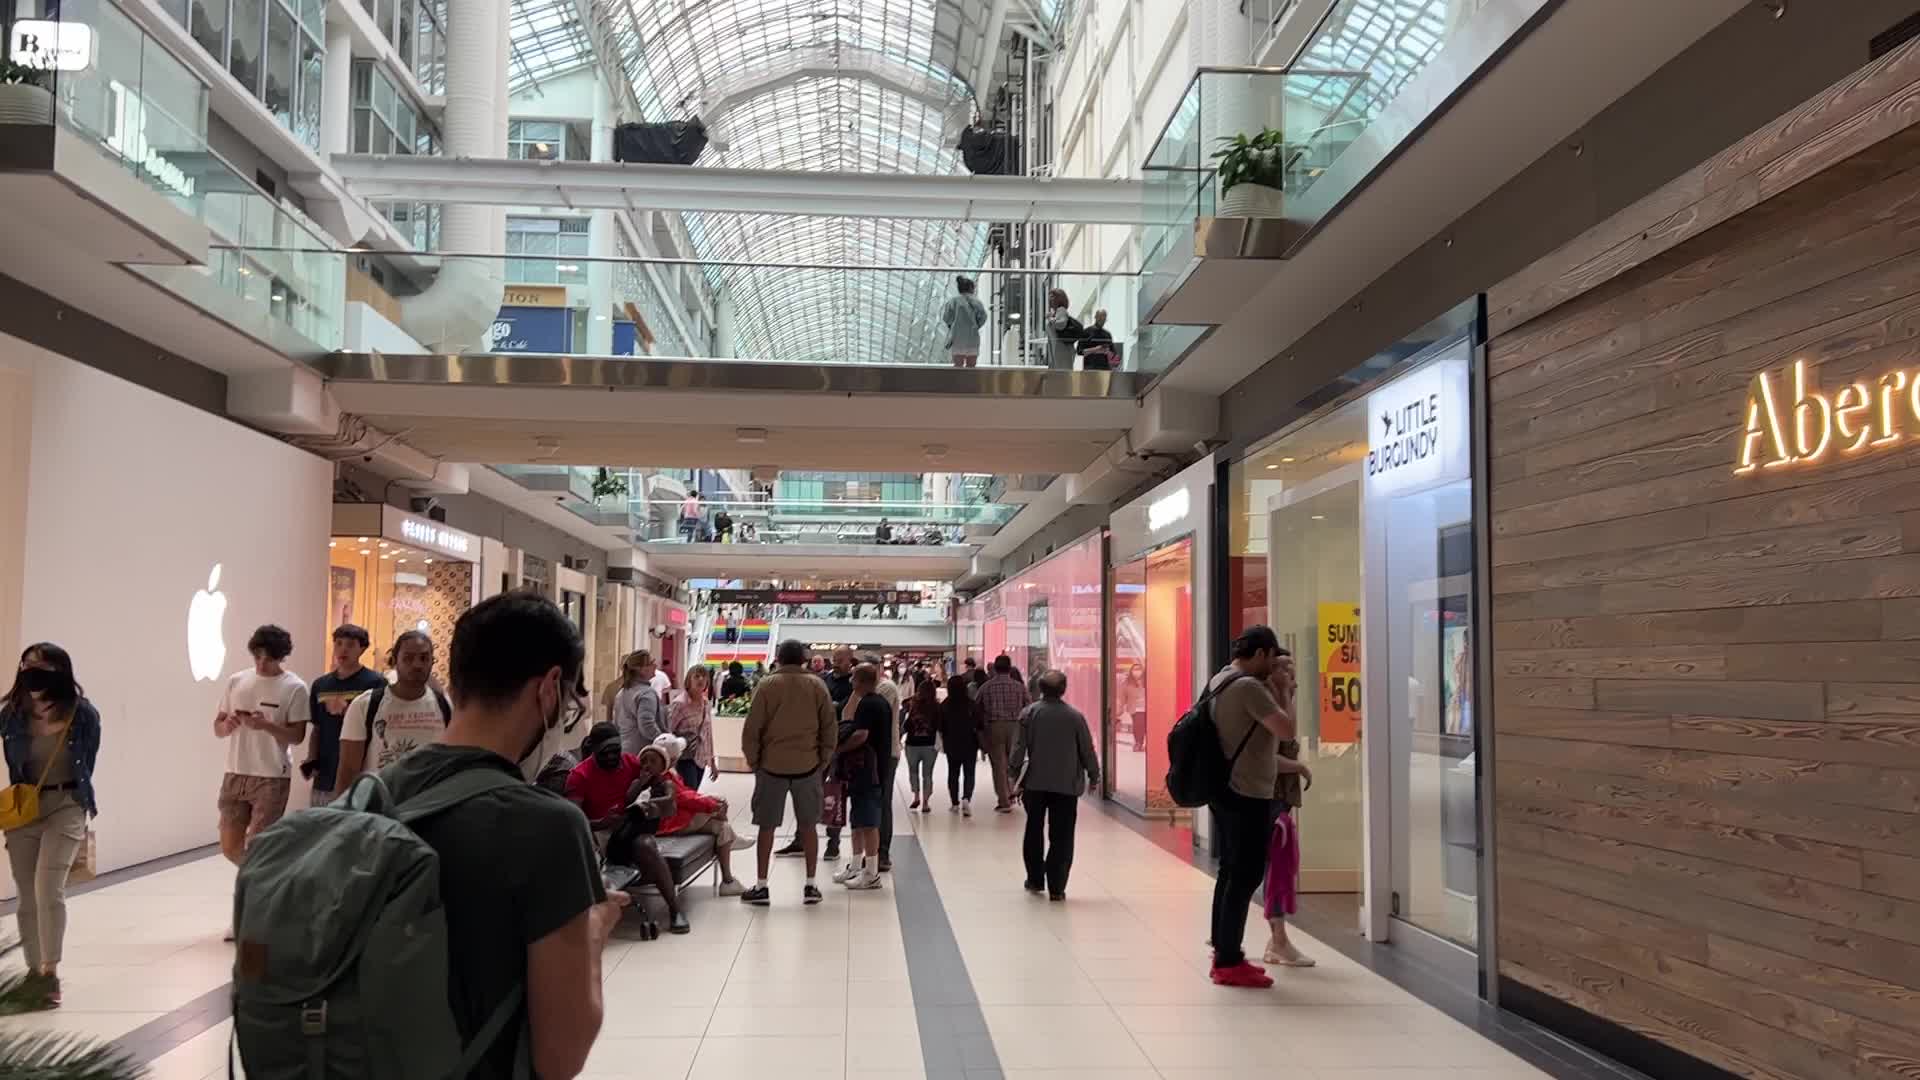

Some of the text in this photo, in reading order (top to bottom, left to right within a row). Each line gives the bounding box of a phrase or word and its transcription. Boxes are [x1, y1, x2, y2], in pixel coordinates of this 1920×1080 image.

[1396, 393, 1438, 436] LITTLE
[1732, 360, 1920, 474] Aber
[1369, 426, 1438, 476] BURGUNDY
